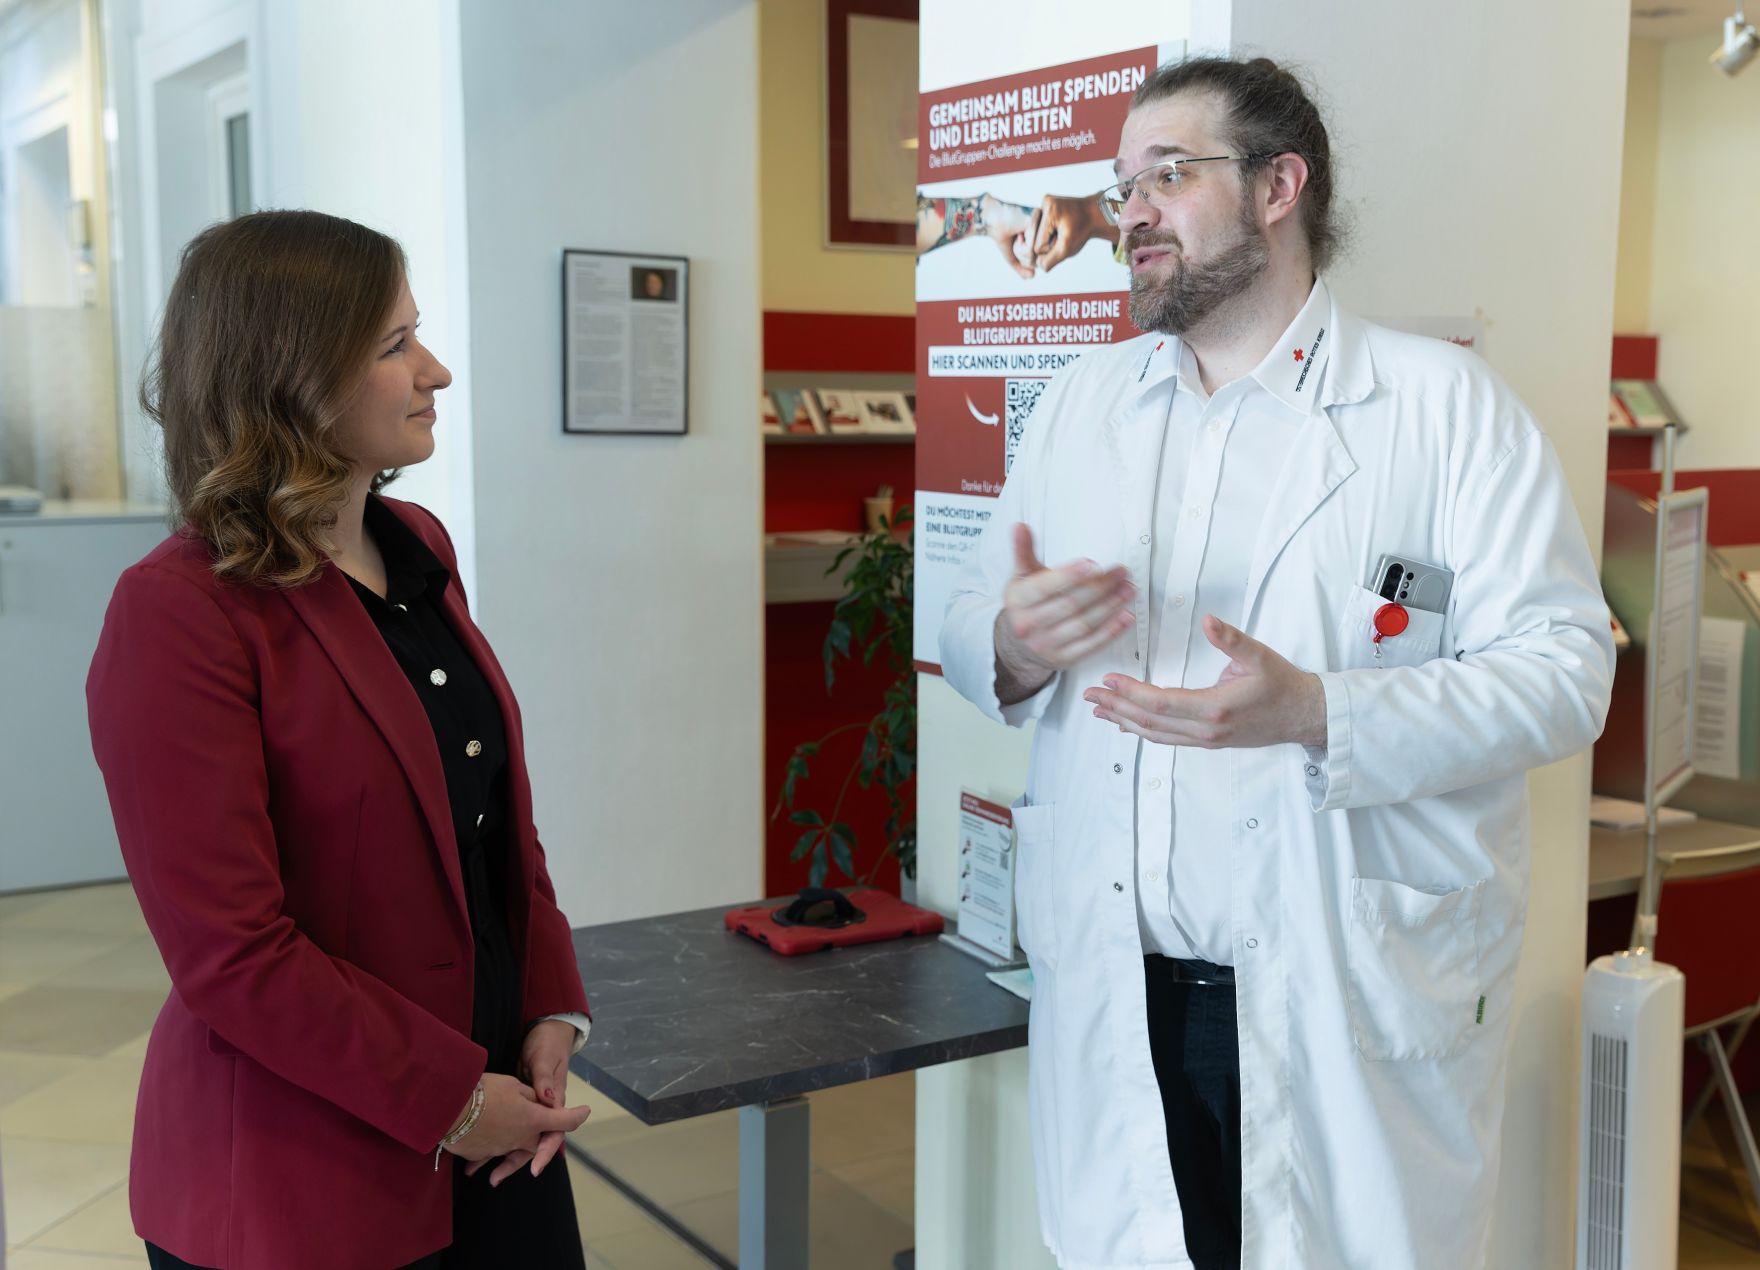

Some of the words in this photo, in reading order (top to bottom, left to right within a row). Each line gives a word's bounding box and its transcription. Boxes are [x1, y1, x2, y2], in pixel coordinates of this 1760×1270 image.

[929, 89, 1019, 127] GEMEINSAM
[1021, 80, 1062, 111] BLUT
[1064, 65, 1146, 104] SPENDEN
[929, 125, 962, 150] UND
[963, 116, 1011, 146] LEBEN
[1013, 106, 1073, 138] RETTEN
[1026, 136, 1051, 154] macht
[1051, 138, 1062, 150] es
[957, 306, 974, 323] DU
[975, 304, 1005, 322] HAST
[1006, 302, 1056, 321] SOEBEN
[1055, 299, 1080, 320] FÜR
[1081, 299, 1121, 319] DEINE
[963, 326, 1034, 345] BLUTGRUPPE
[1036, 324, 1114, 343] GESPENDET?
[932, 353, 955, 370] HIER
[957, 353, 1008, 370] SCANNEN
[1010, 354, 1035, 369] UND
[1038, 354, 1081, 369] SPEND
[926, 505, 936, 516] DU
[937, 505, 975, 520] MÖCHTEST
[926, 522, 941, 534] EINE
